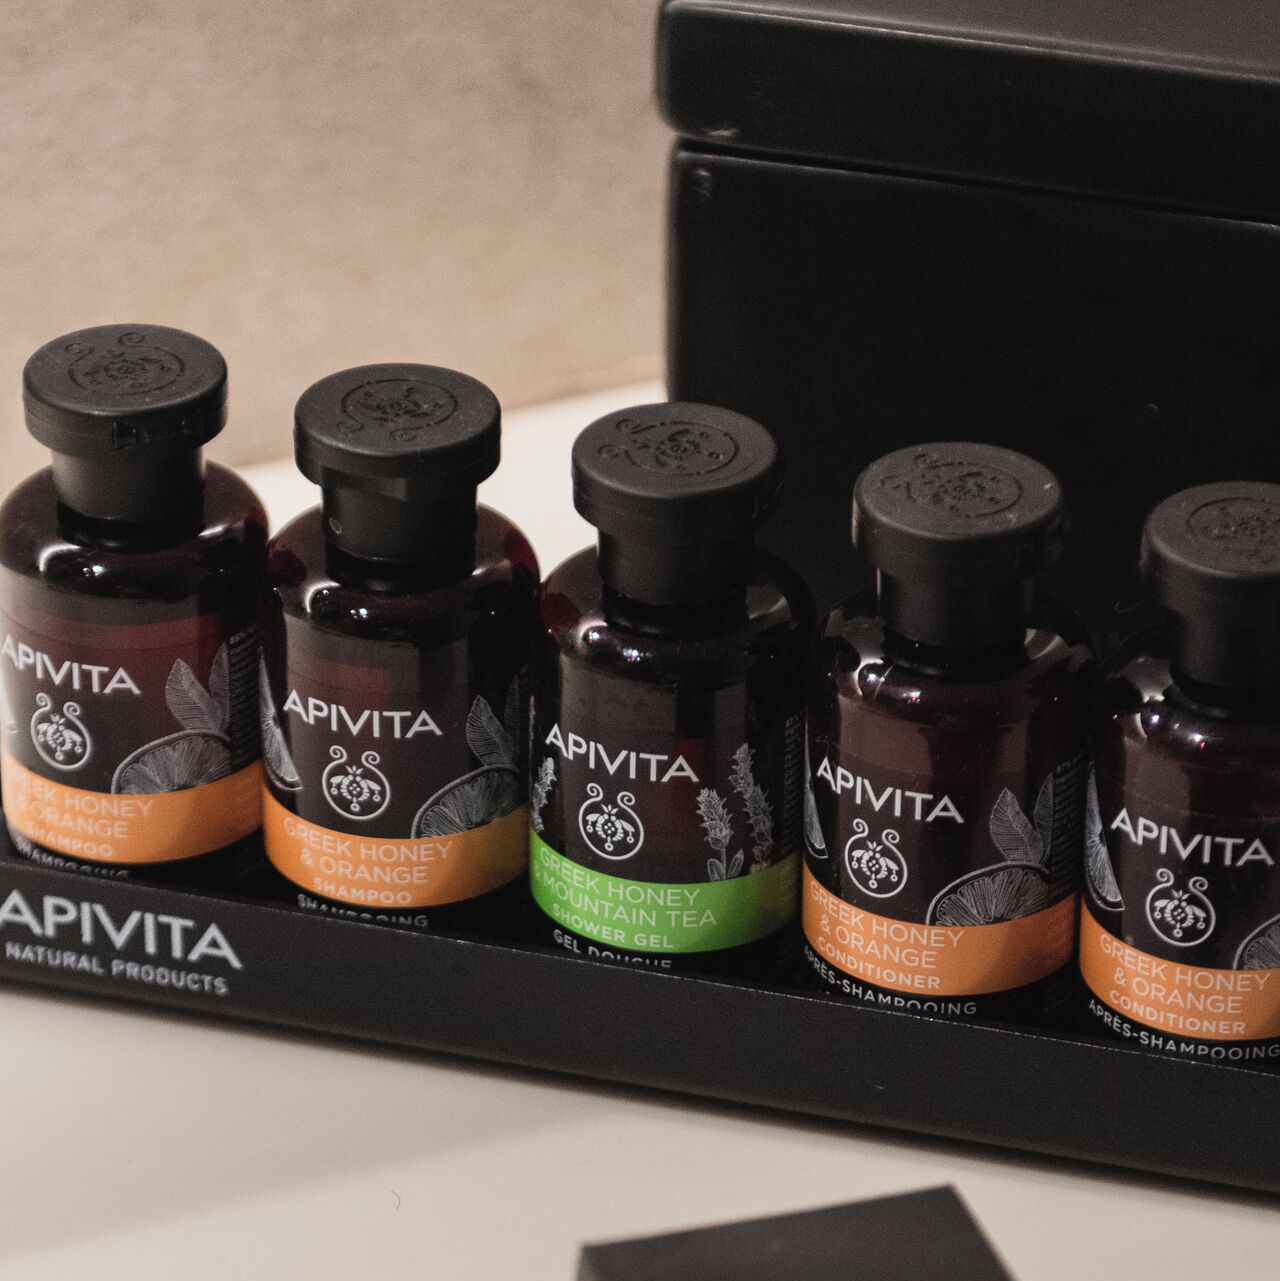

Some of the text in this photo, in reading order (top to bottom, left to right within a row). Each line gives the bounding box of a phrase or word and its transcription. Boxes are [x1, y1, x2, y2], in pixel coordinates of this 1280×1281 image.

[1, 633, 142, 695] APIVITA
[283, 688, 443, 740] APIVITA
[545, 722, 700, 783] APIVITA
[63, 791, 153, 818] HONEY
[816, 755, 965, 825] APIVITA
[29, 800, 129, 839] ORANGE
[284, 816, 454, 864] GREEK HONEY
[1111, 807, 1275, 867] APIVITA
[300, 848, 428, 886] & ORANGE
[313, 877, 413, 906] SHAMPOO
[540, 846, 701, 907] GREEK HONEY
[543, 871, 657, 928] MOUNTAIN
[665, 909, 718, 929] TEA
[552, 902, 674, 949] SHOWER GEL
[810, 880, 967, 949] GREEK HONEY
[553, 929, 581, 953] GEL
[818, 936, 942, 990] CONDITIONER
[835, 925, 937, 969] ORANGE
[1100, 933, 1271, 993] GREEK HONEY
[4, 941, 231, 997] NATURAL PRODUCTS
[1114, 966, 1243, 1014] & ORANGE
[1110, 990, 1247, 1035] CONDITIONER
